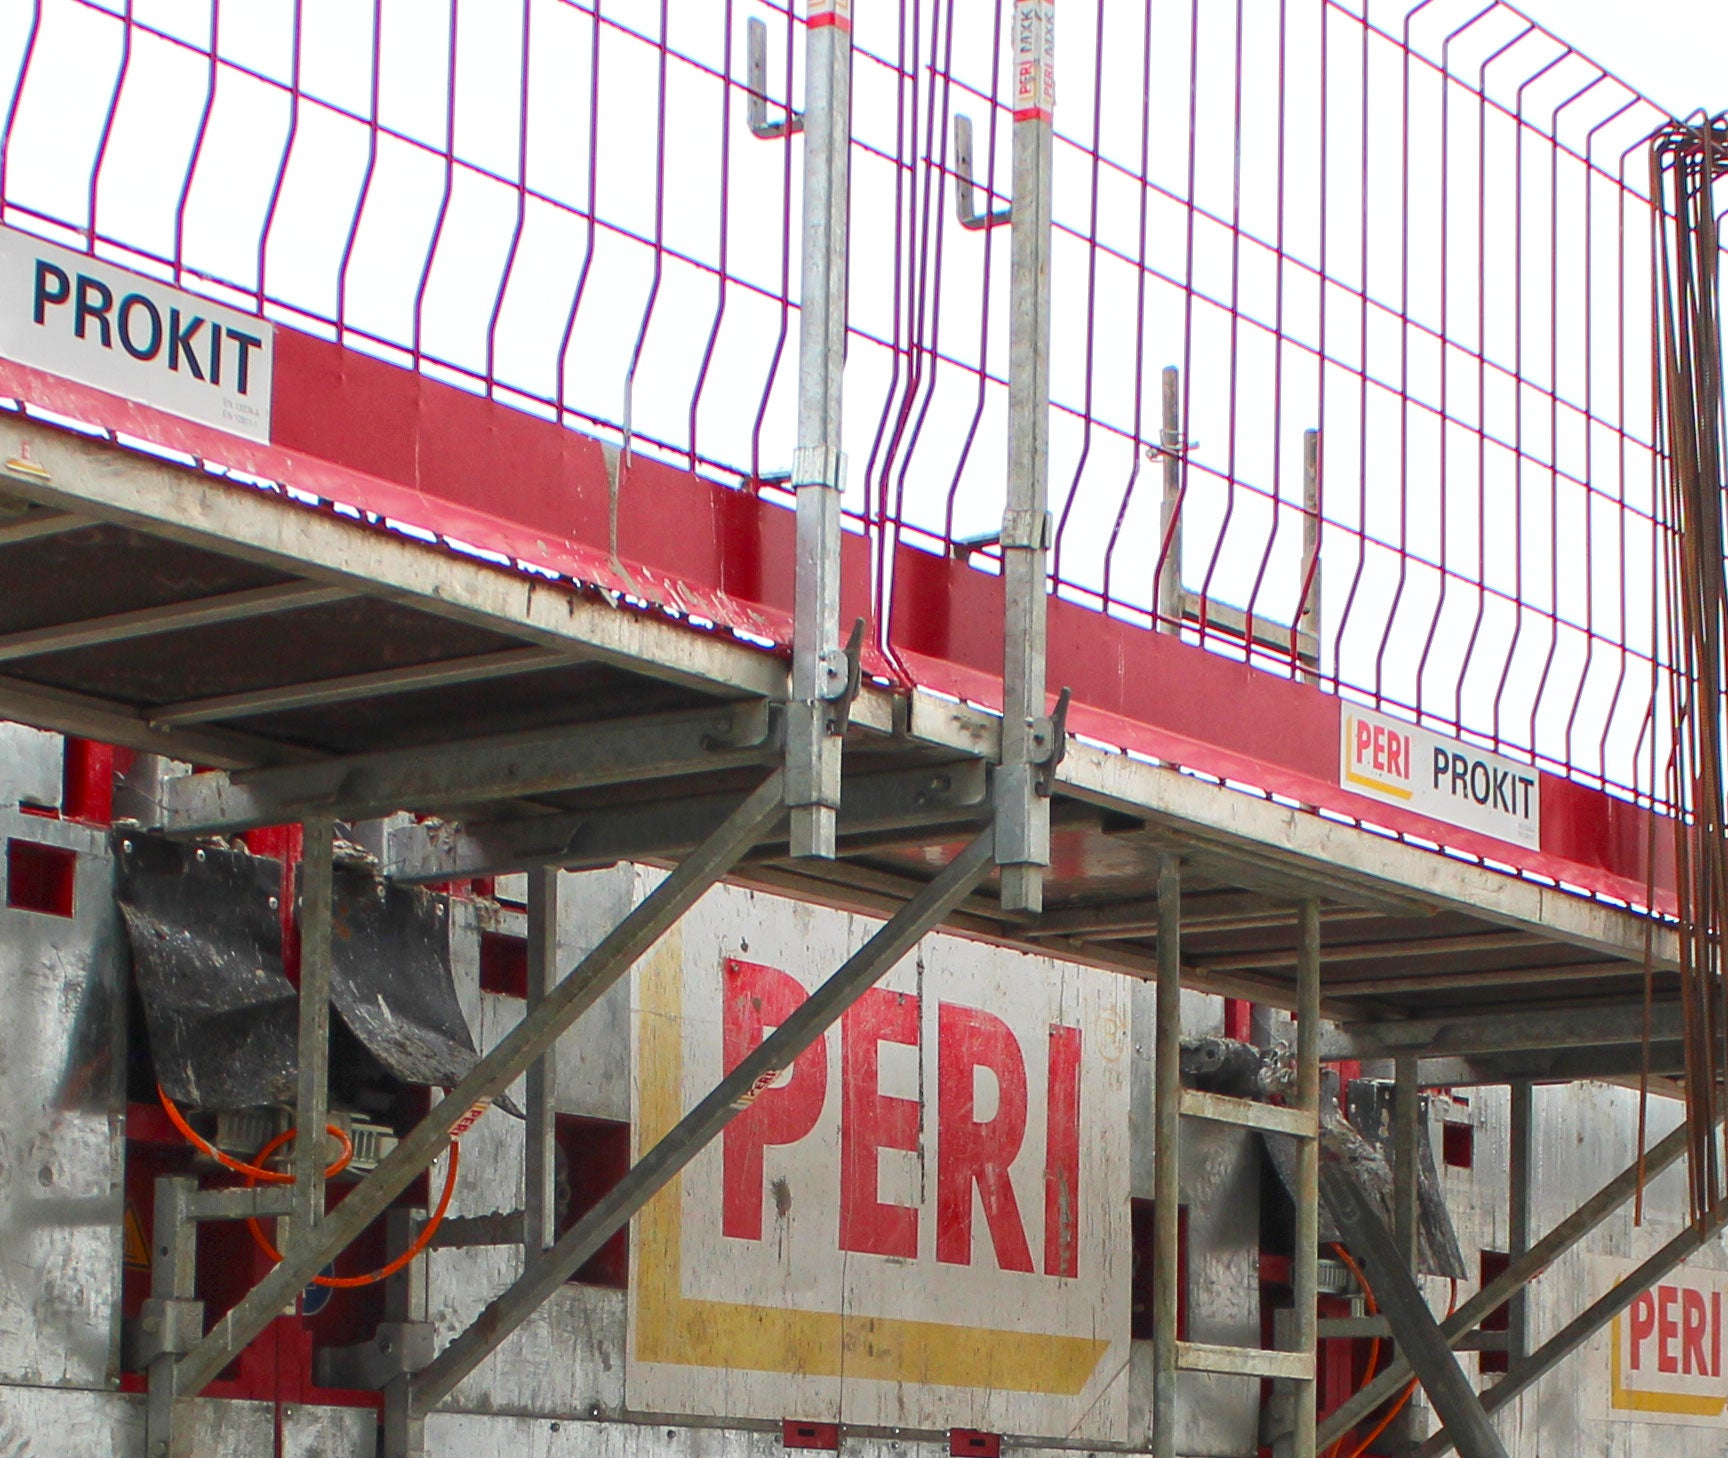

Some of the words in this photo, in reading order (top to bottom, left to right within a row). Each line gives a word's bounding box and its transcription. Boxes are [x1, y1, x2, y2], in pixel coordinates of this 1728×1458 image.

[33, 258, 262, 395] PROKIT
[1356, 720, 1411, 780] PERI
[1434, 746, 1534, 819] PROKIT
[450, 1109, 483, 1136] PERI
[722, 957, 1082, 1280] PERI
[1630, 1285, 1721, 1377] PERI
